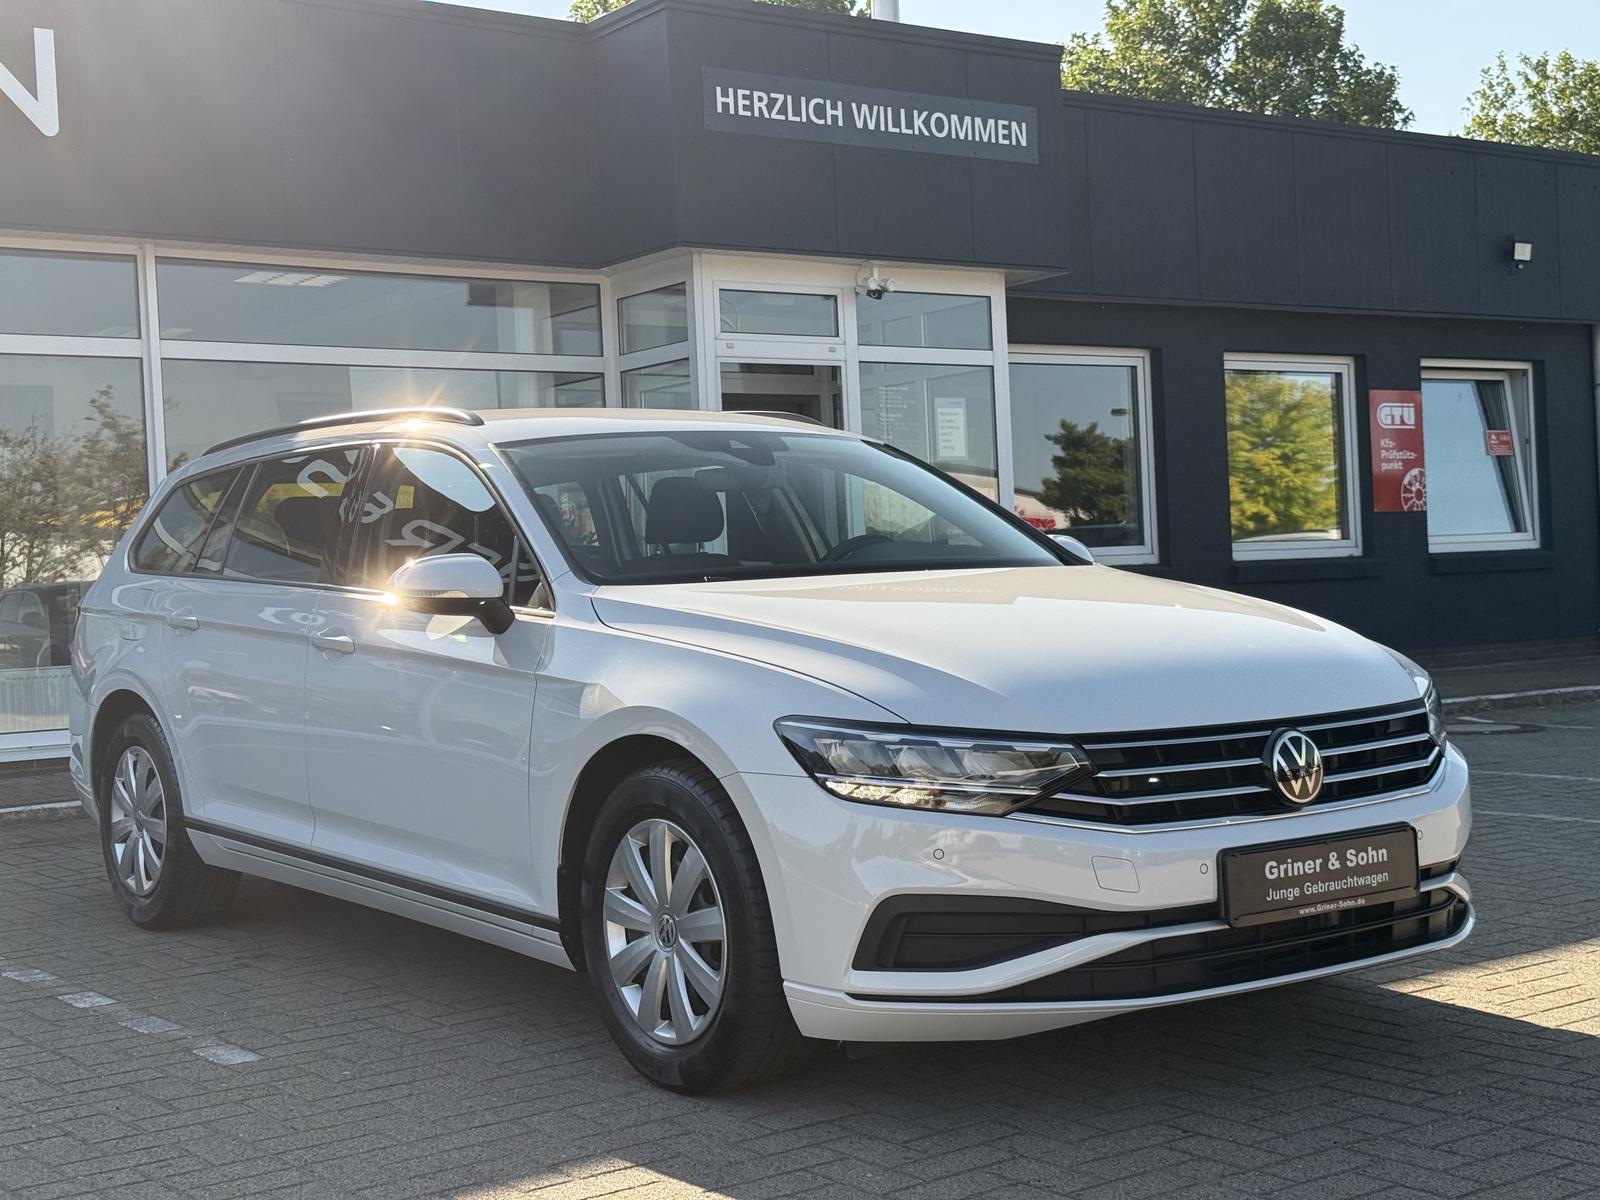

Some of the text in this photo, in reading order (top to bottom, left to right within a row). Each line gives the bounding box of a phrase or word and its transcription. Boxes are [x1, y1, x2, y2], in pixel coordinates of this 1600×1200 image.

[715, 85, 1028, 147] HERZLICH WILLKOMMEN
[1264, 846, 1388, 880] Griner & Sohn
[1266, 871, 1389, 902] Junge Gebrauchtwagen
[1298, 897, 1366, 915] www.Griner-Sohn.de
